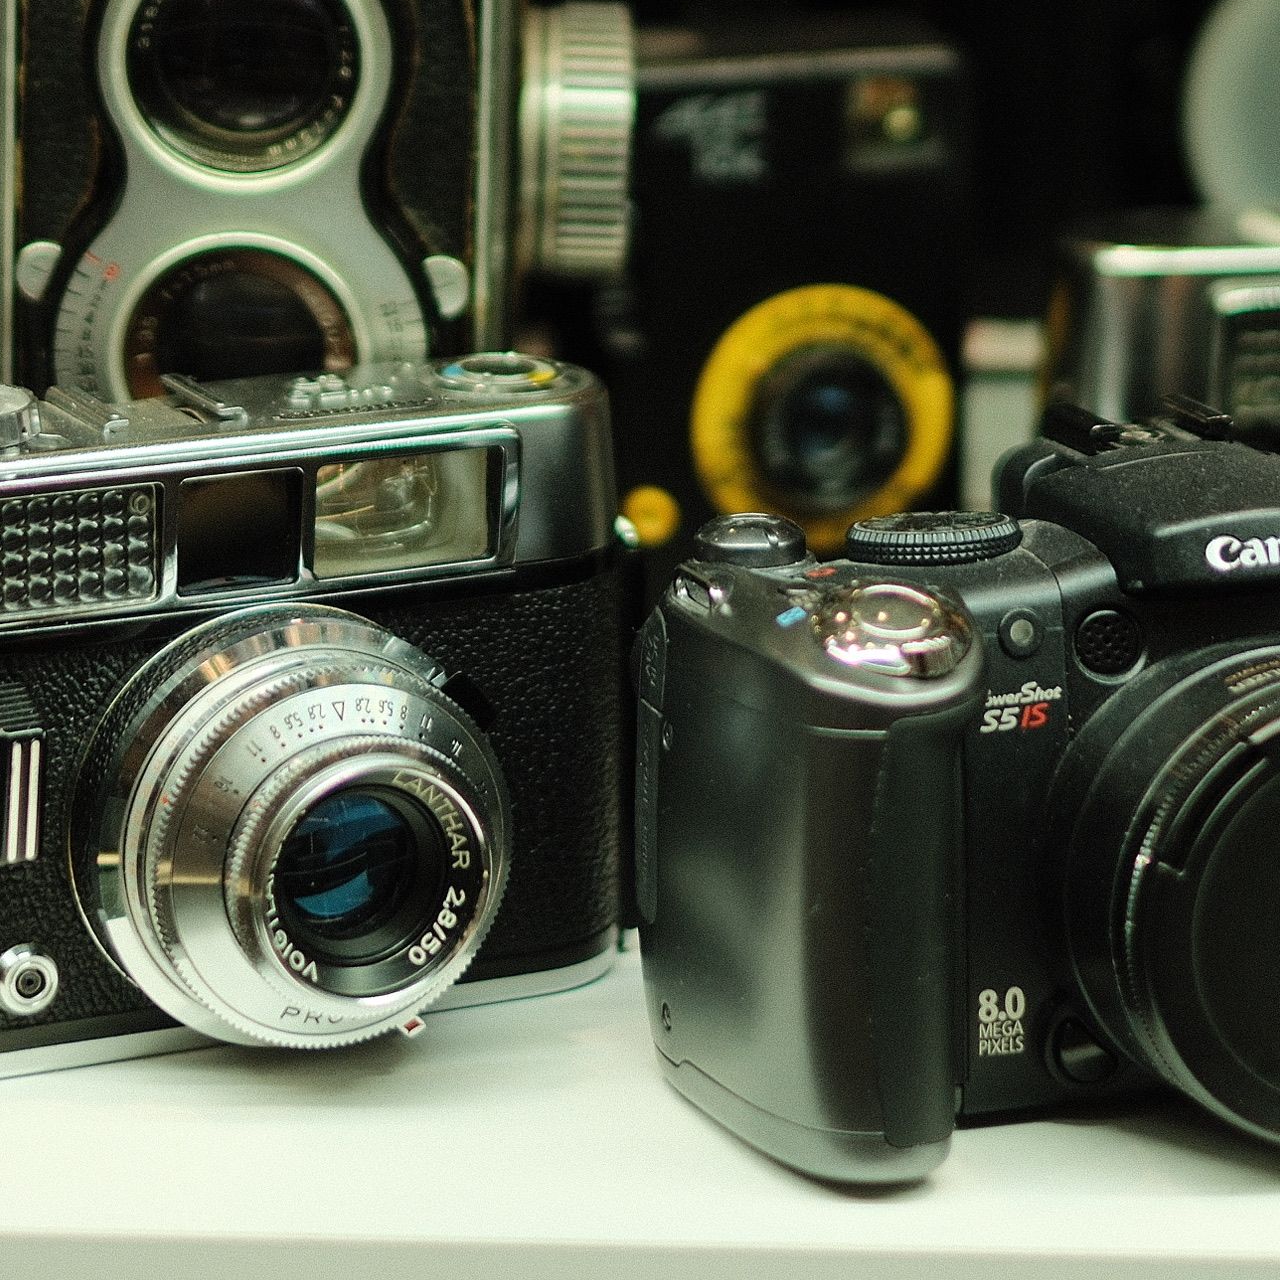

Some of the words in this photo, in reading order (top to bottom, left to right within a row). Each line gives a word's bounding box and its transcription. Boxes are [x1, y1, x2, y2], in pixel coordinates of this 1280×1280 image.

[984, 680, 1062, 709] owerShot
[979, 706, 1020, 734] S5
[1020, 702, 1051, 733] IS
[391, 769, 472, 870] LANTHAR
[978, 986, 1025, 1025] 8.0
[979, 1020, 1025, 1039] MEGA
[979, 1035, 1025, 1056] PIXELS
